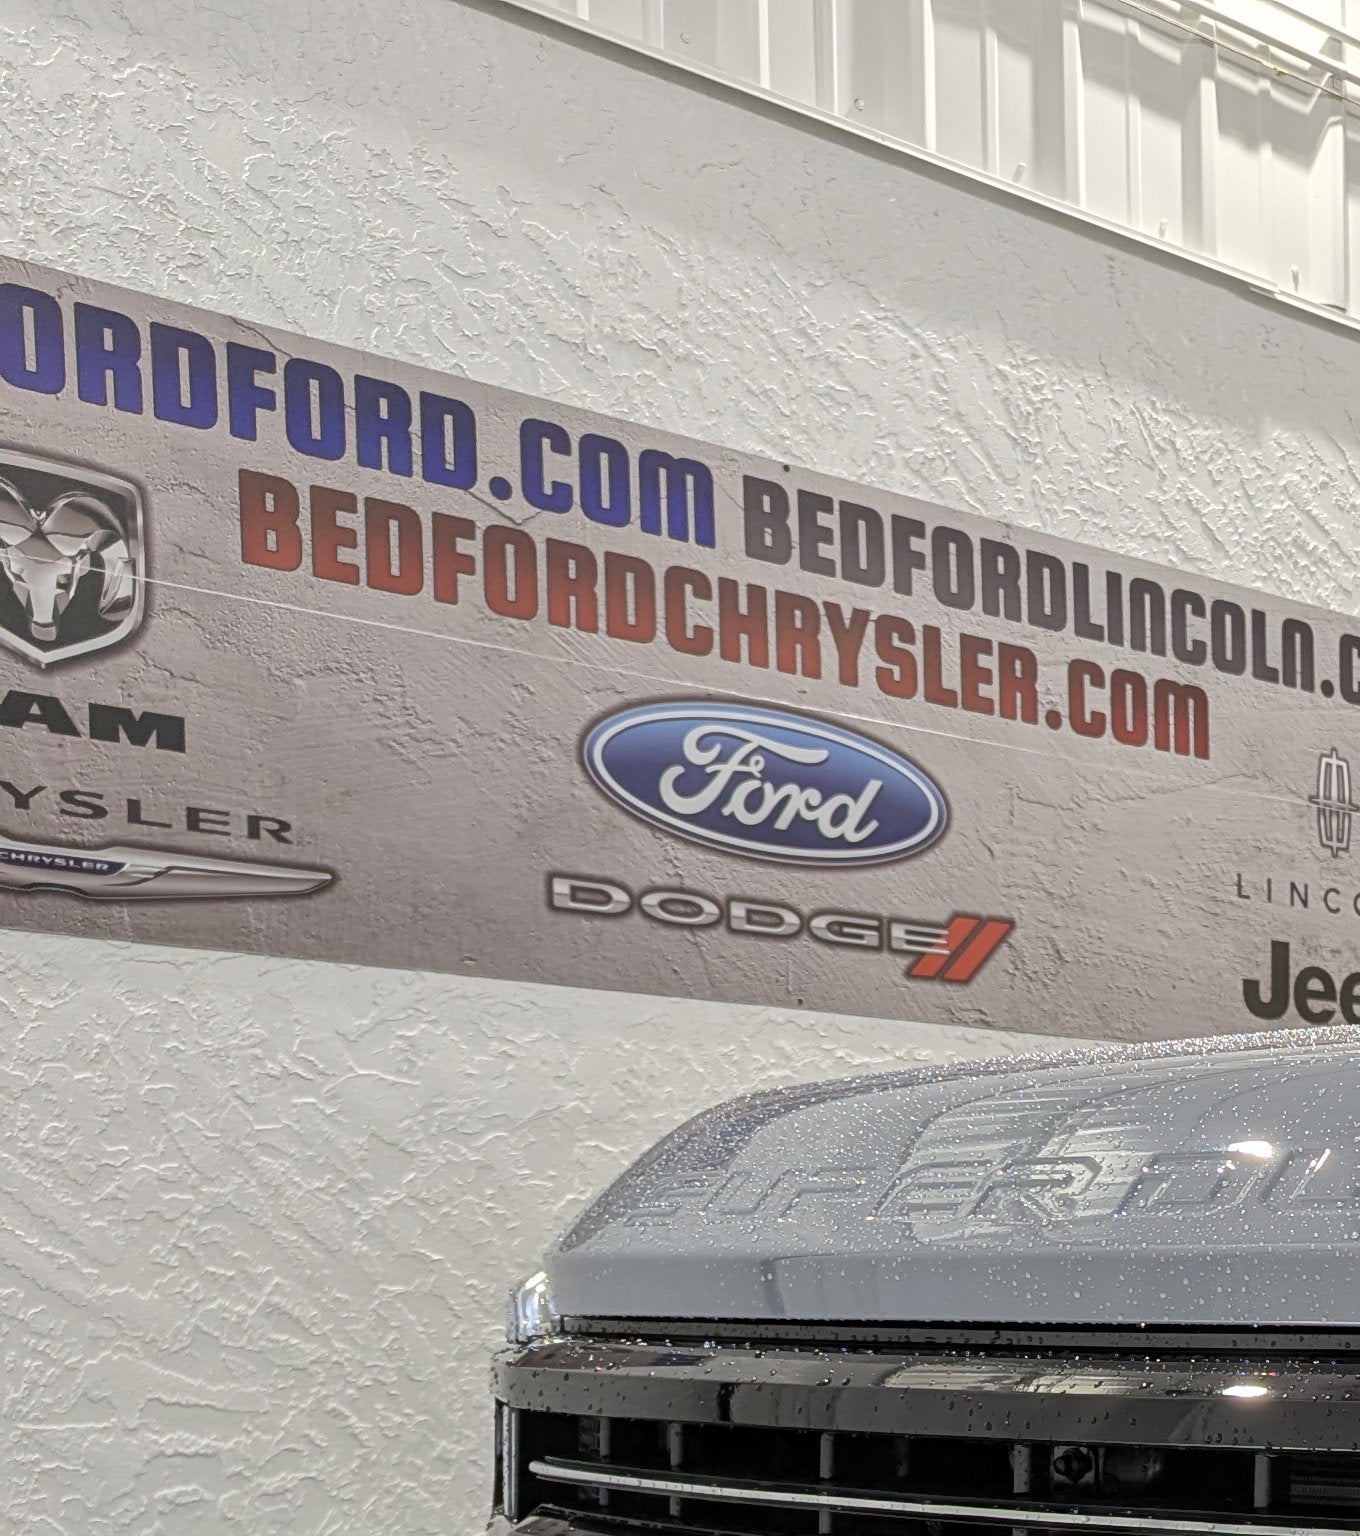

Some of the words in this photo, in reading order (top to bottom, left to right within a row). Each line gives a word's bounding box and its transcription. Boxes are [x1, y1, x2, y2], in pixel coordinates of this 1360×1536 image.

[0, 283, 715, 549] ORDFORD.COM
[238, 468, 1209, 760] BEDFORDCHRYSLER.COM
[0, 690, 186, 753] AM
[0, 780, 293, 844] YSLER
[659, 724, 883, 843] Ford
[552, 877, 951, 955] DODGE
